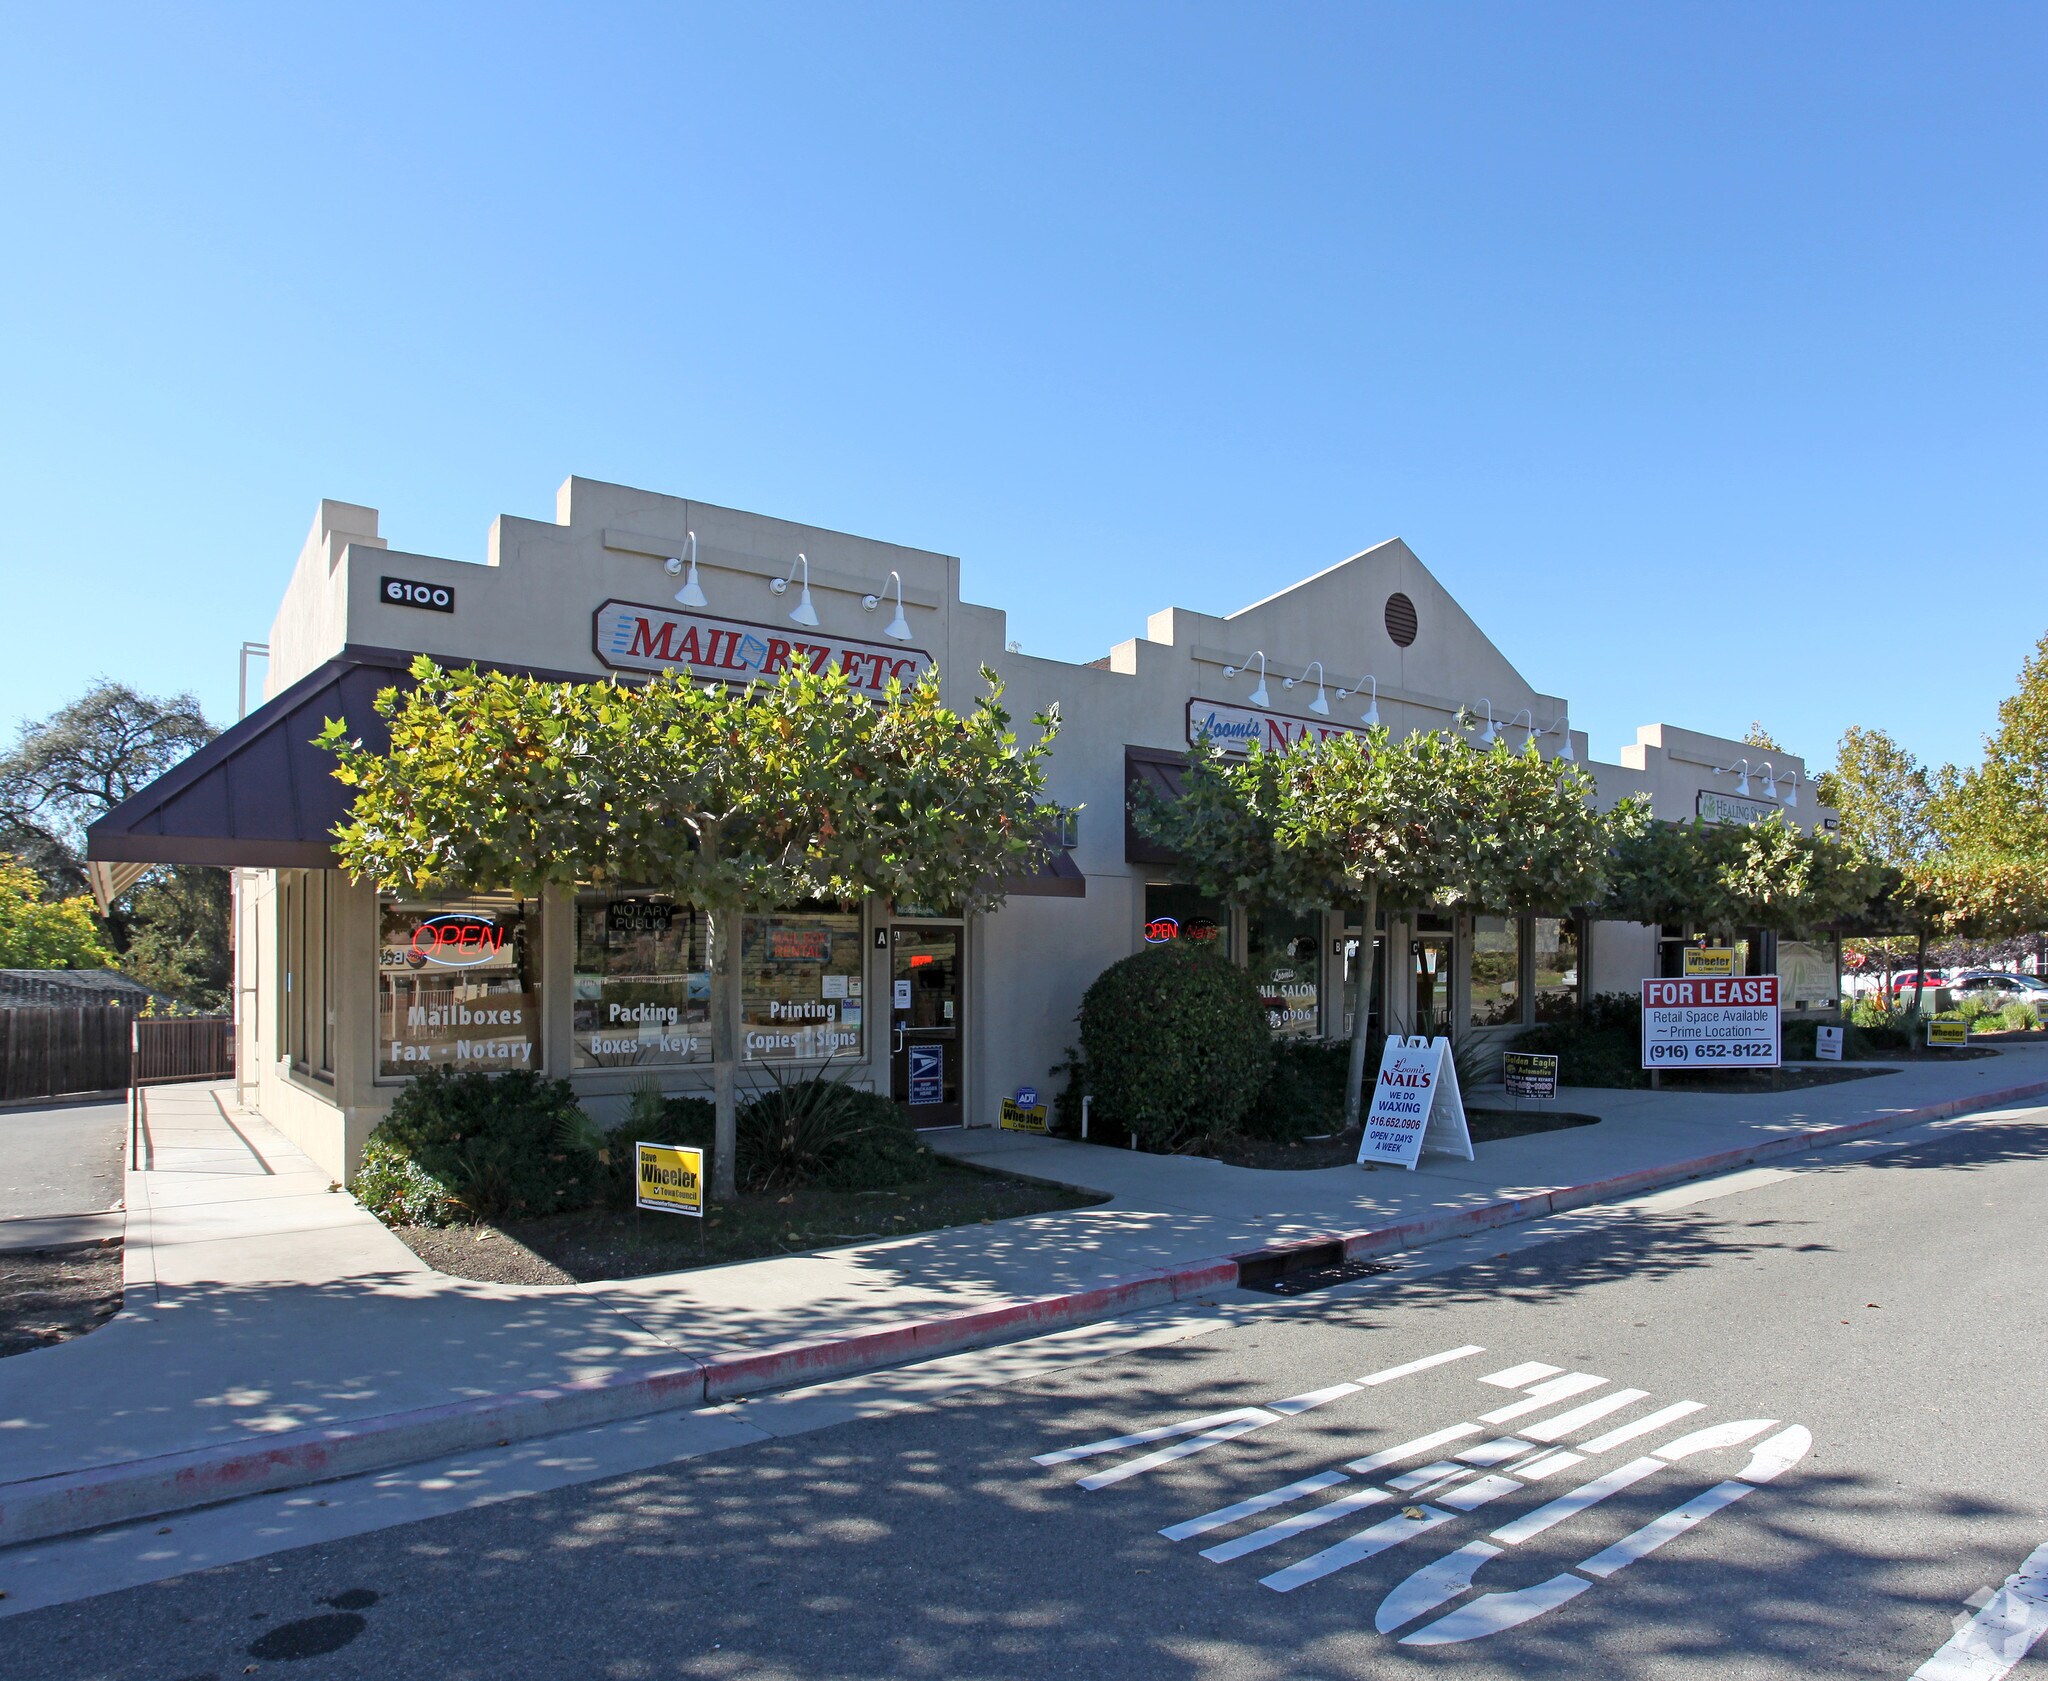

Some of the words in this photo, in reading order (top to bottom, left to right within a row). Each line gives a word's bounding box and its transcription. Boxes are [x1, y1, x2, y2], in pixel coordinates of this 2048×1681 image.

[387, 582, 449, 606] 6100
[626, 617, 747, 670] MAIL
[1197, 712, 1262, 738] Loomis
[1716, 801, 1750, 820] HEALING
[613, 904, 673, 916] NOTARY
[615, 918, 667, 930] PUBLIC
[1144, 923, 1178, 938] OPEN
[412, 925, 504, 955] OPEN
[878, 932, 886, 944] A
[1336, 942, 1341, 952] B
[1688, 957, 1729, 966] Wheeler
[1256, 985, 1276, 998] AIL
[1281, 984, 1317, 998] SALON
[1649, 983, 1694, 1005] FOR
[1701, 981, 1772, 1004] LEASE
[408, 1005, 522, 1026] Mailboxes
[609, 1002, 678, 1025] Packing
[770, 1000, 836, 1021] Printing
[1653, 1011, 1683, 1023] Retail
[1686, 1011, 1719, 1024] Space
[1723, 1010, 1768, 1022] Available
[1670, 1026, 1702, 1037] Prime
[1705, 1025, 1751, 1037] Location
[591, 1035, 638, 1054] Boxes
[660, 1033, 698, 1056] Keys
[746, 1030, 796, 1053] Copies
[817, 1029, 856, 1050] Signs
[391, 1041, 431, 1062] Fax
[457, 1039, 533, 1062] Notary
[1650, 1045, 1688, 1061] (916)
[1695, 1043, 1772, 1058] 652-8122
[1392, 1058, 1425, 1073] Loomis
[1533, 1057, 1556, 1069] Eagle
[1518, 1067, 1552, 1075] Automotive
[1381, 1070, 1431, 1088] NAILS
[1018, 1094, 1035, 1103] ADT
[1390, 1091, 1401, 1099] WE
[1403, 1092, 1415, 1100] DO
[1379, 1101, 1420, 1113] WAXING
[1370, 1116, 1420, 1129] 916.652.0906
[1370, 1131, 1388, 1140] OPEN
[1395, 1133, 1413, 1143] DAYS
[1375, 1142, 1380, 1150] A
[1382, 1143, 1402, 1152] WEEK
[641, 1151, 657, 1162] Dave
[641, 1163, 696, 1188] Wheeler
[661, 1187, 675, 1197] Town
[676, 1189, 696, 1200] Council
